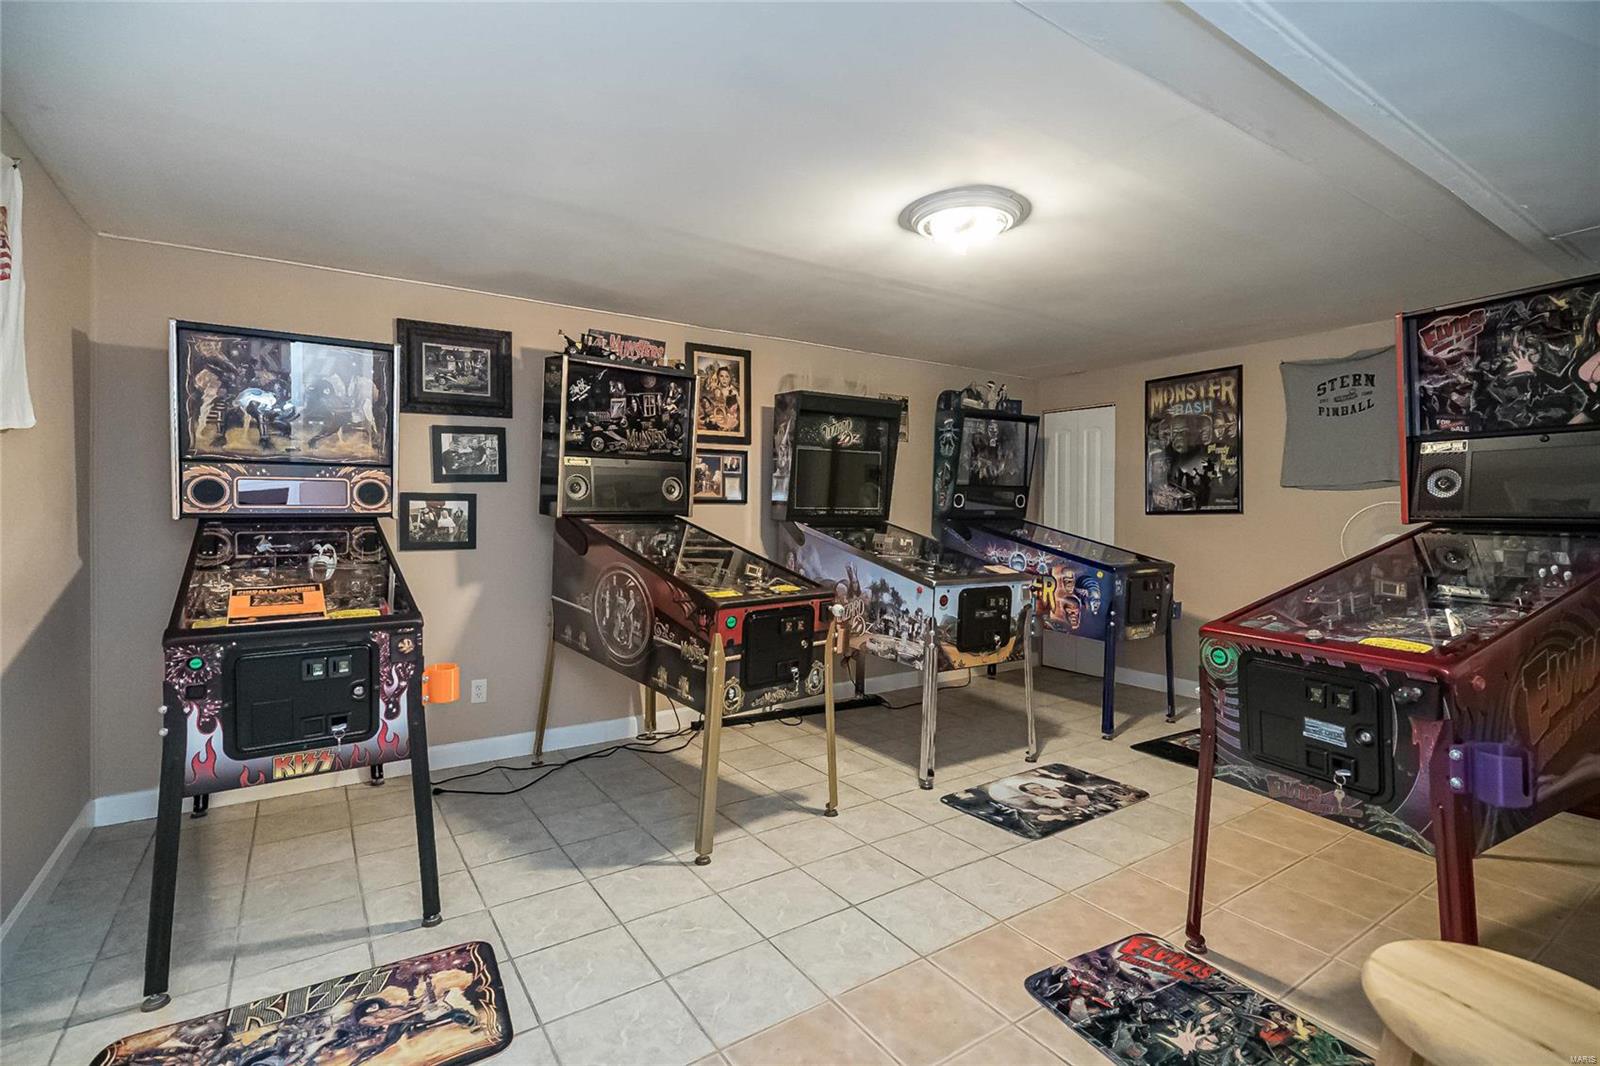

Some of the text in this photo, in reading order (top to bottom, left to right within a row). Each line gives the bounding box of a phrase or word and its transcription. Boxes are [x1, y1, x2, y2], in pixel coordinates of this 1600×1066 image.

[1150, 376, 1236, 417] MONSTER
[1316, 373, 1376, 397] STERN
[1172, 400, 1213, 416] BASH
[1318, 398, 1375, 417] PINBALL
[272, 750, 336, 780] KISS
[226, 966, 393, 1032] KISS
